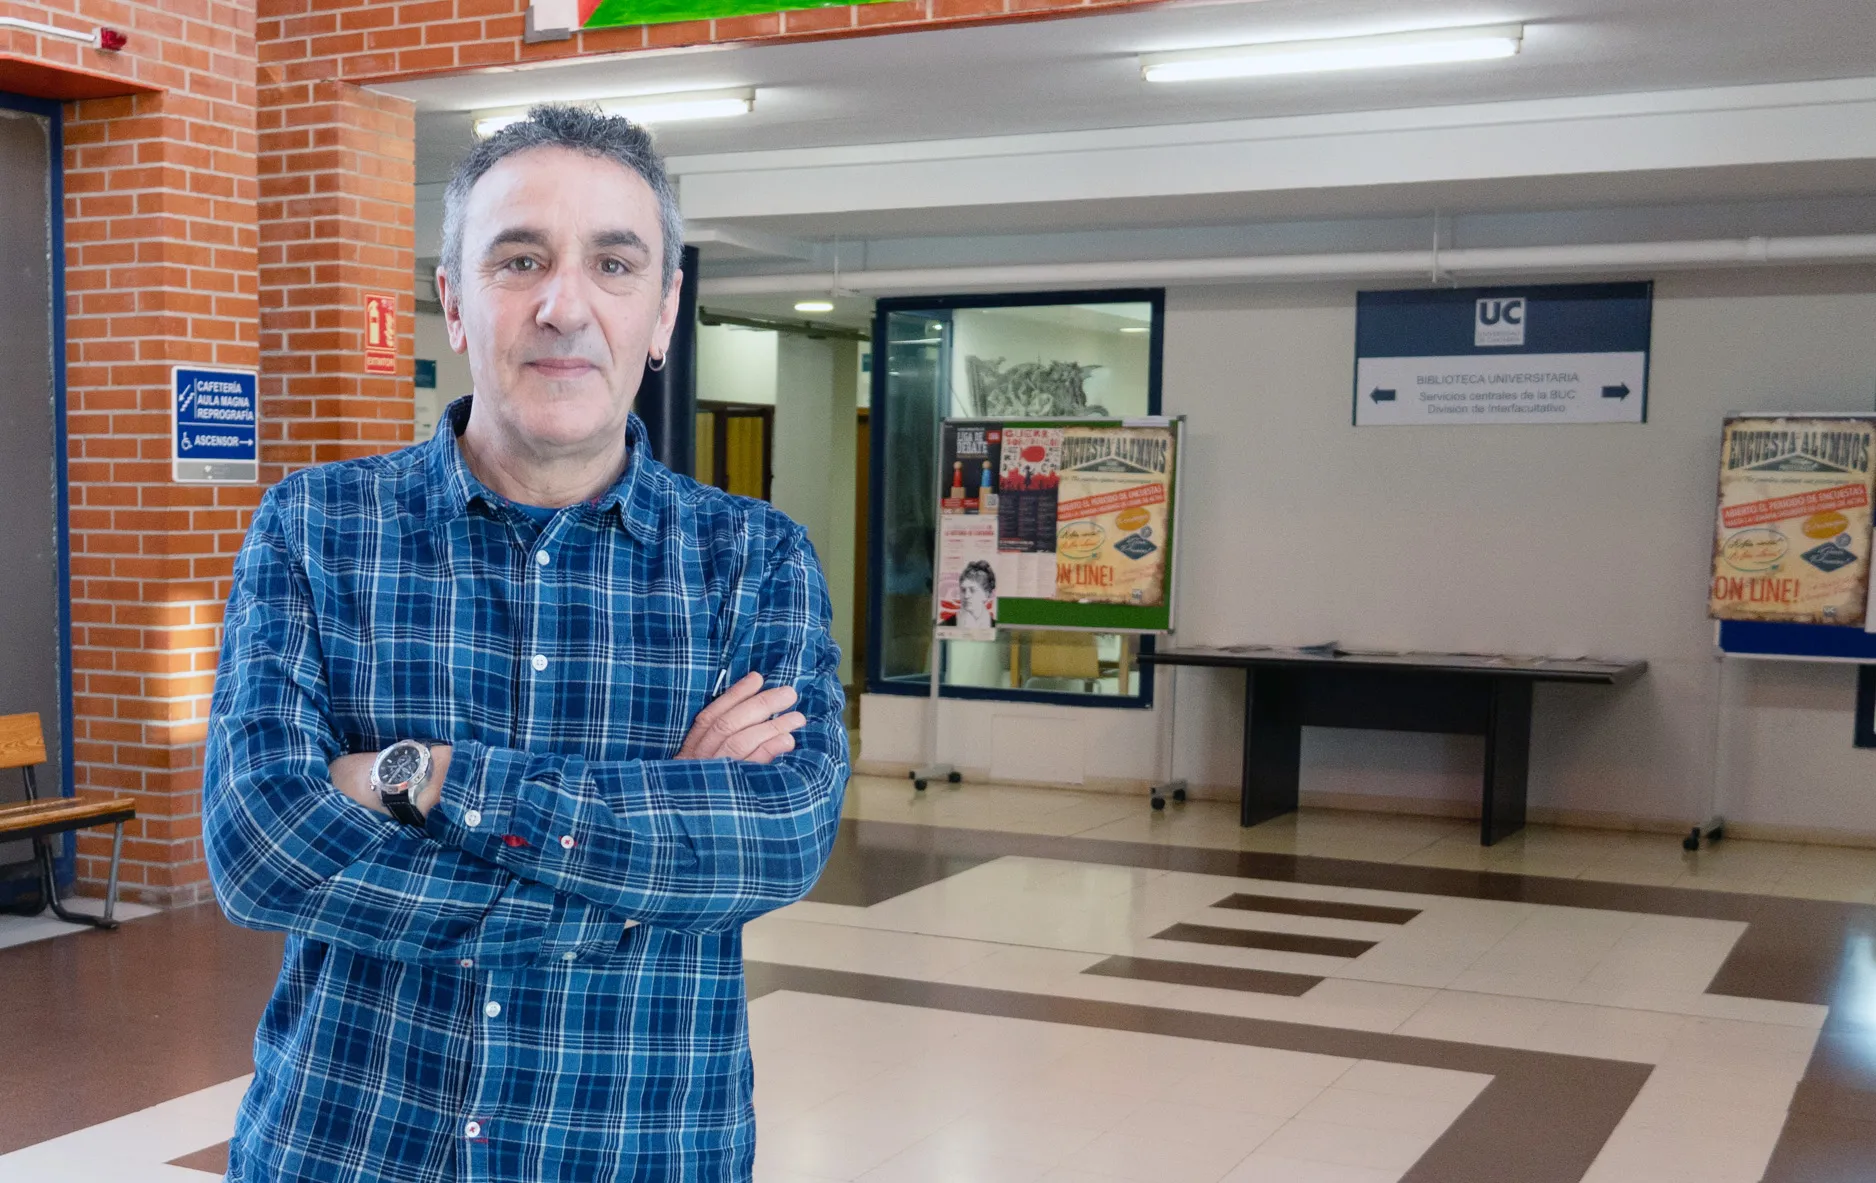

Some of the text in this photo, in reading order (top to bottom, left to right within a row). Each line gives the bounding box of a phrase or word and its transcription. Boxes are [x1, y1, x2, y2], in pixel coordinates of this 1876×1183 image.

[1480, 301, 1521, 325] UC
[1416, 372, 1580, 386] BIBLIOTECA UNIVERSITARIA
[197, 380, 242, 394] CAFETERÍA
[197, 394, 250, 408] AULA MAGNA
[1419, 389, 1576, 401] Servicios centrales de la BUC
[197, 407, 254, 421] REPROGRAFÍA
[1471, 403, 1485, 414] de
[1488, 403, 1566, 414] Interfacultativo
[194, 434, 239, 447] ASCENSOR
[957, 431, 974, 442] LIGA
[975, 431, 984, 442] DE
[957, 441, 988, 454] DEBATE
[1728, 430, 1870, 473] ENCUESTA ALUMNOS
[1115, 437, 1167, 474] ALUMNOS
[1076, 564, 1114, 587] LINE!
[1714, 575, 1743, 600] ON
[1751, 577, 1799, 603] LINE!
